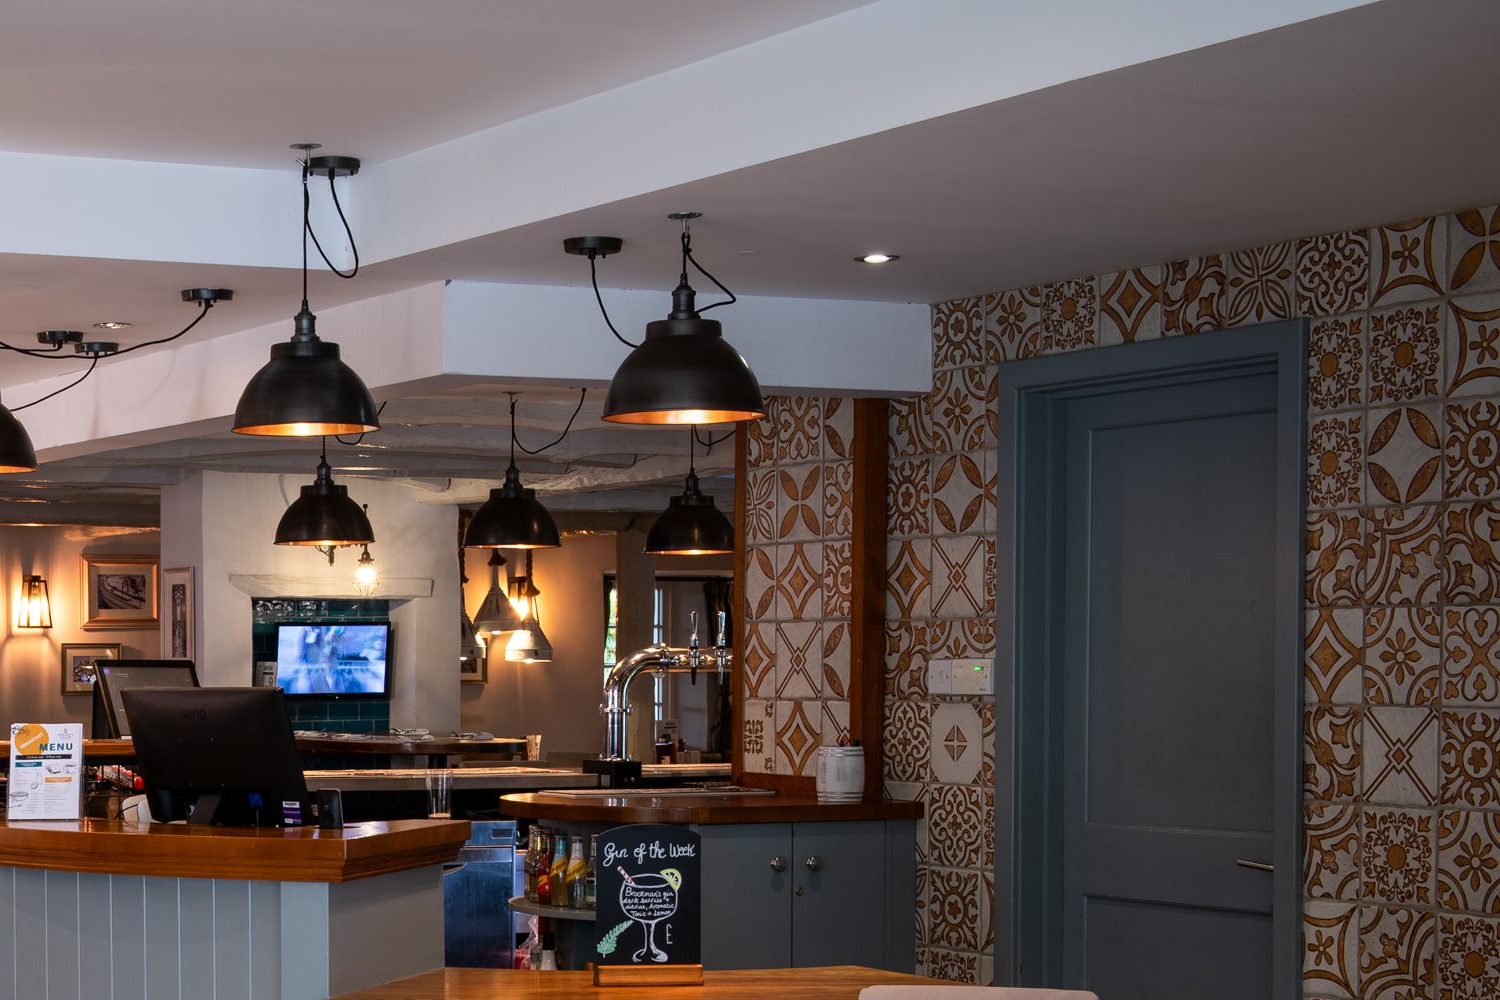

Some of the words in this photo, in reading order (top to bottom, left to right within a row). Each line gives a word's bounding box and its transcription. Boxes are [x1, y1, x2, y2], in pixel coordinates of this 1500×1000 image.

[39, 743, 73, 751] MENU
[603, 843, 628, 866] Gin
[634, 843, 647, 864] of
[649, 840, 667, 859] the
[625, 887, 662, 898] Brockman's
[663, 889, 674, 899] gin
[653, 909, 671, 917] Lemon
